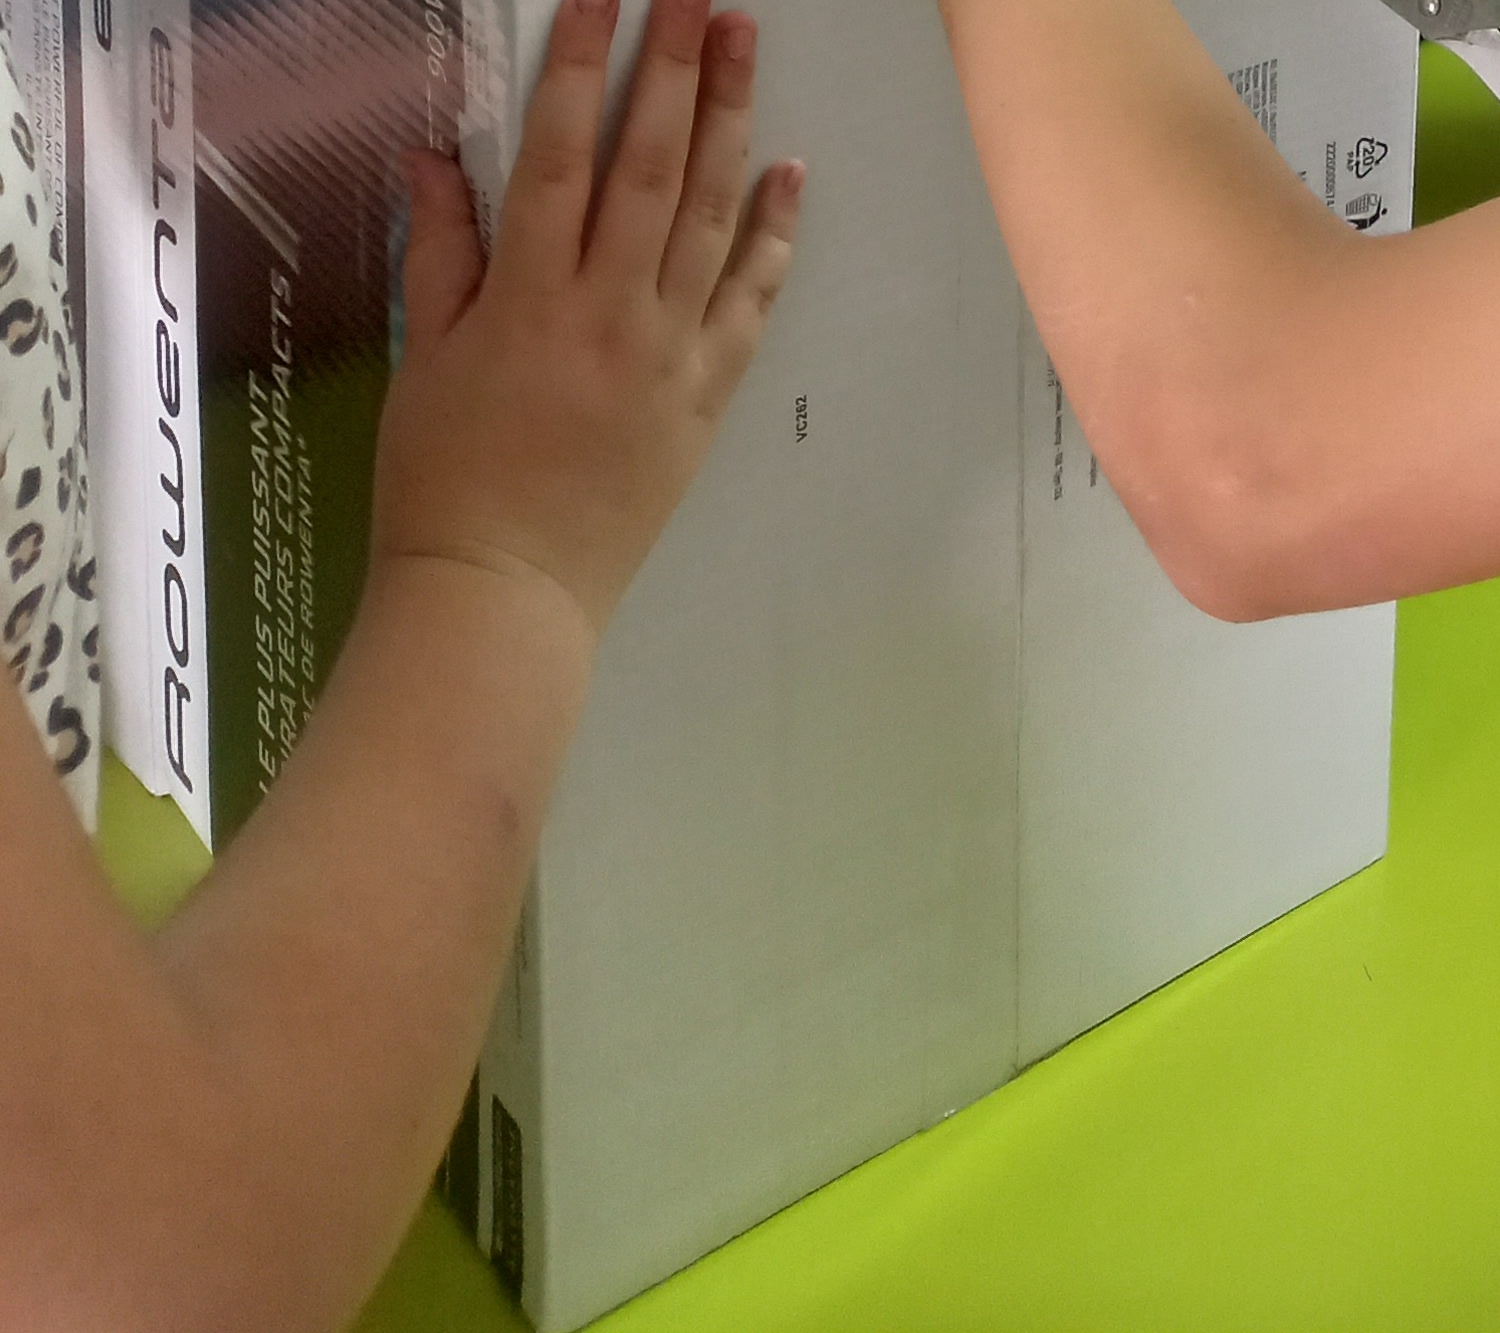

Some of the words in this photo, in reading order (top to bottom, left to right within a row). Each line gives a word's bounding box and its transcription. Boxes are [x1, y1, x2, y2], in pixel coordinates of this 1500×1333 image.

[1346, 150, 1354, 173] PAP
[1361, 146, 1375, 167] 20
[270, 266, 295, 537] COMPACTS
[249, 369, 273, 614] PUISSANT
[255, 614, 277, 741] PLUS
[300, 634, 315, 683] DE
